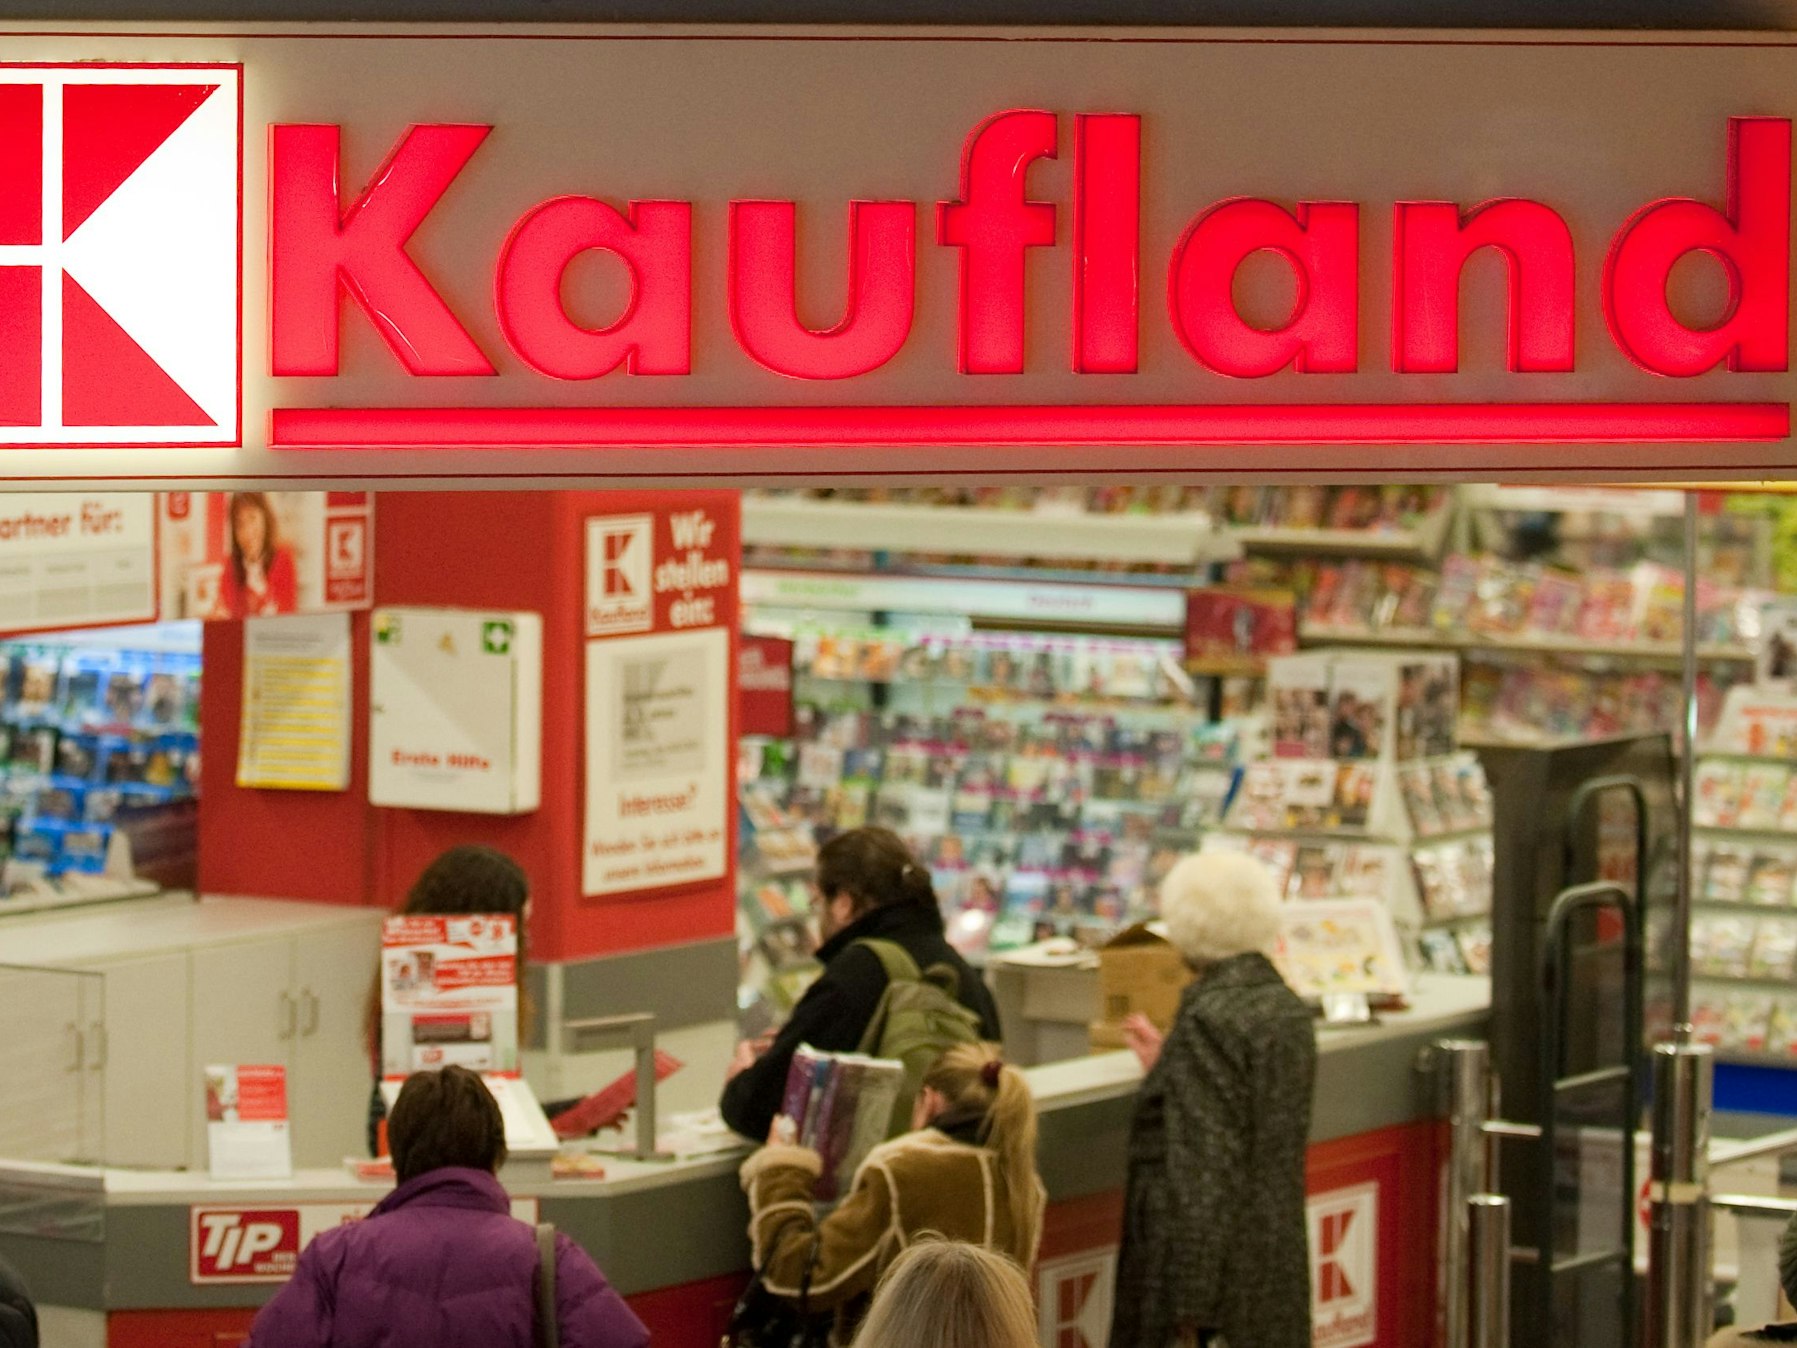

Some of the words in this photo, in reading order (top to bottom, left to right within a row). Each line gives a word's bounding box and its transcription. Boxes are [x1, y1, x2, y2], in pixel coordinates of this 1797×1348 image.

[267, 108, 1793, 381] Kaufland
[670, 510, 715, 550] Wir
[655, 549, 729, 593] stellen
